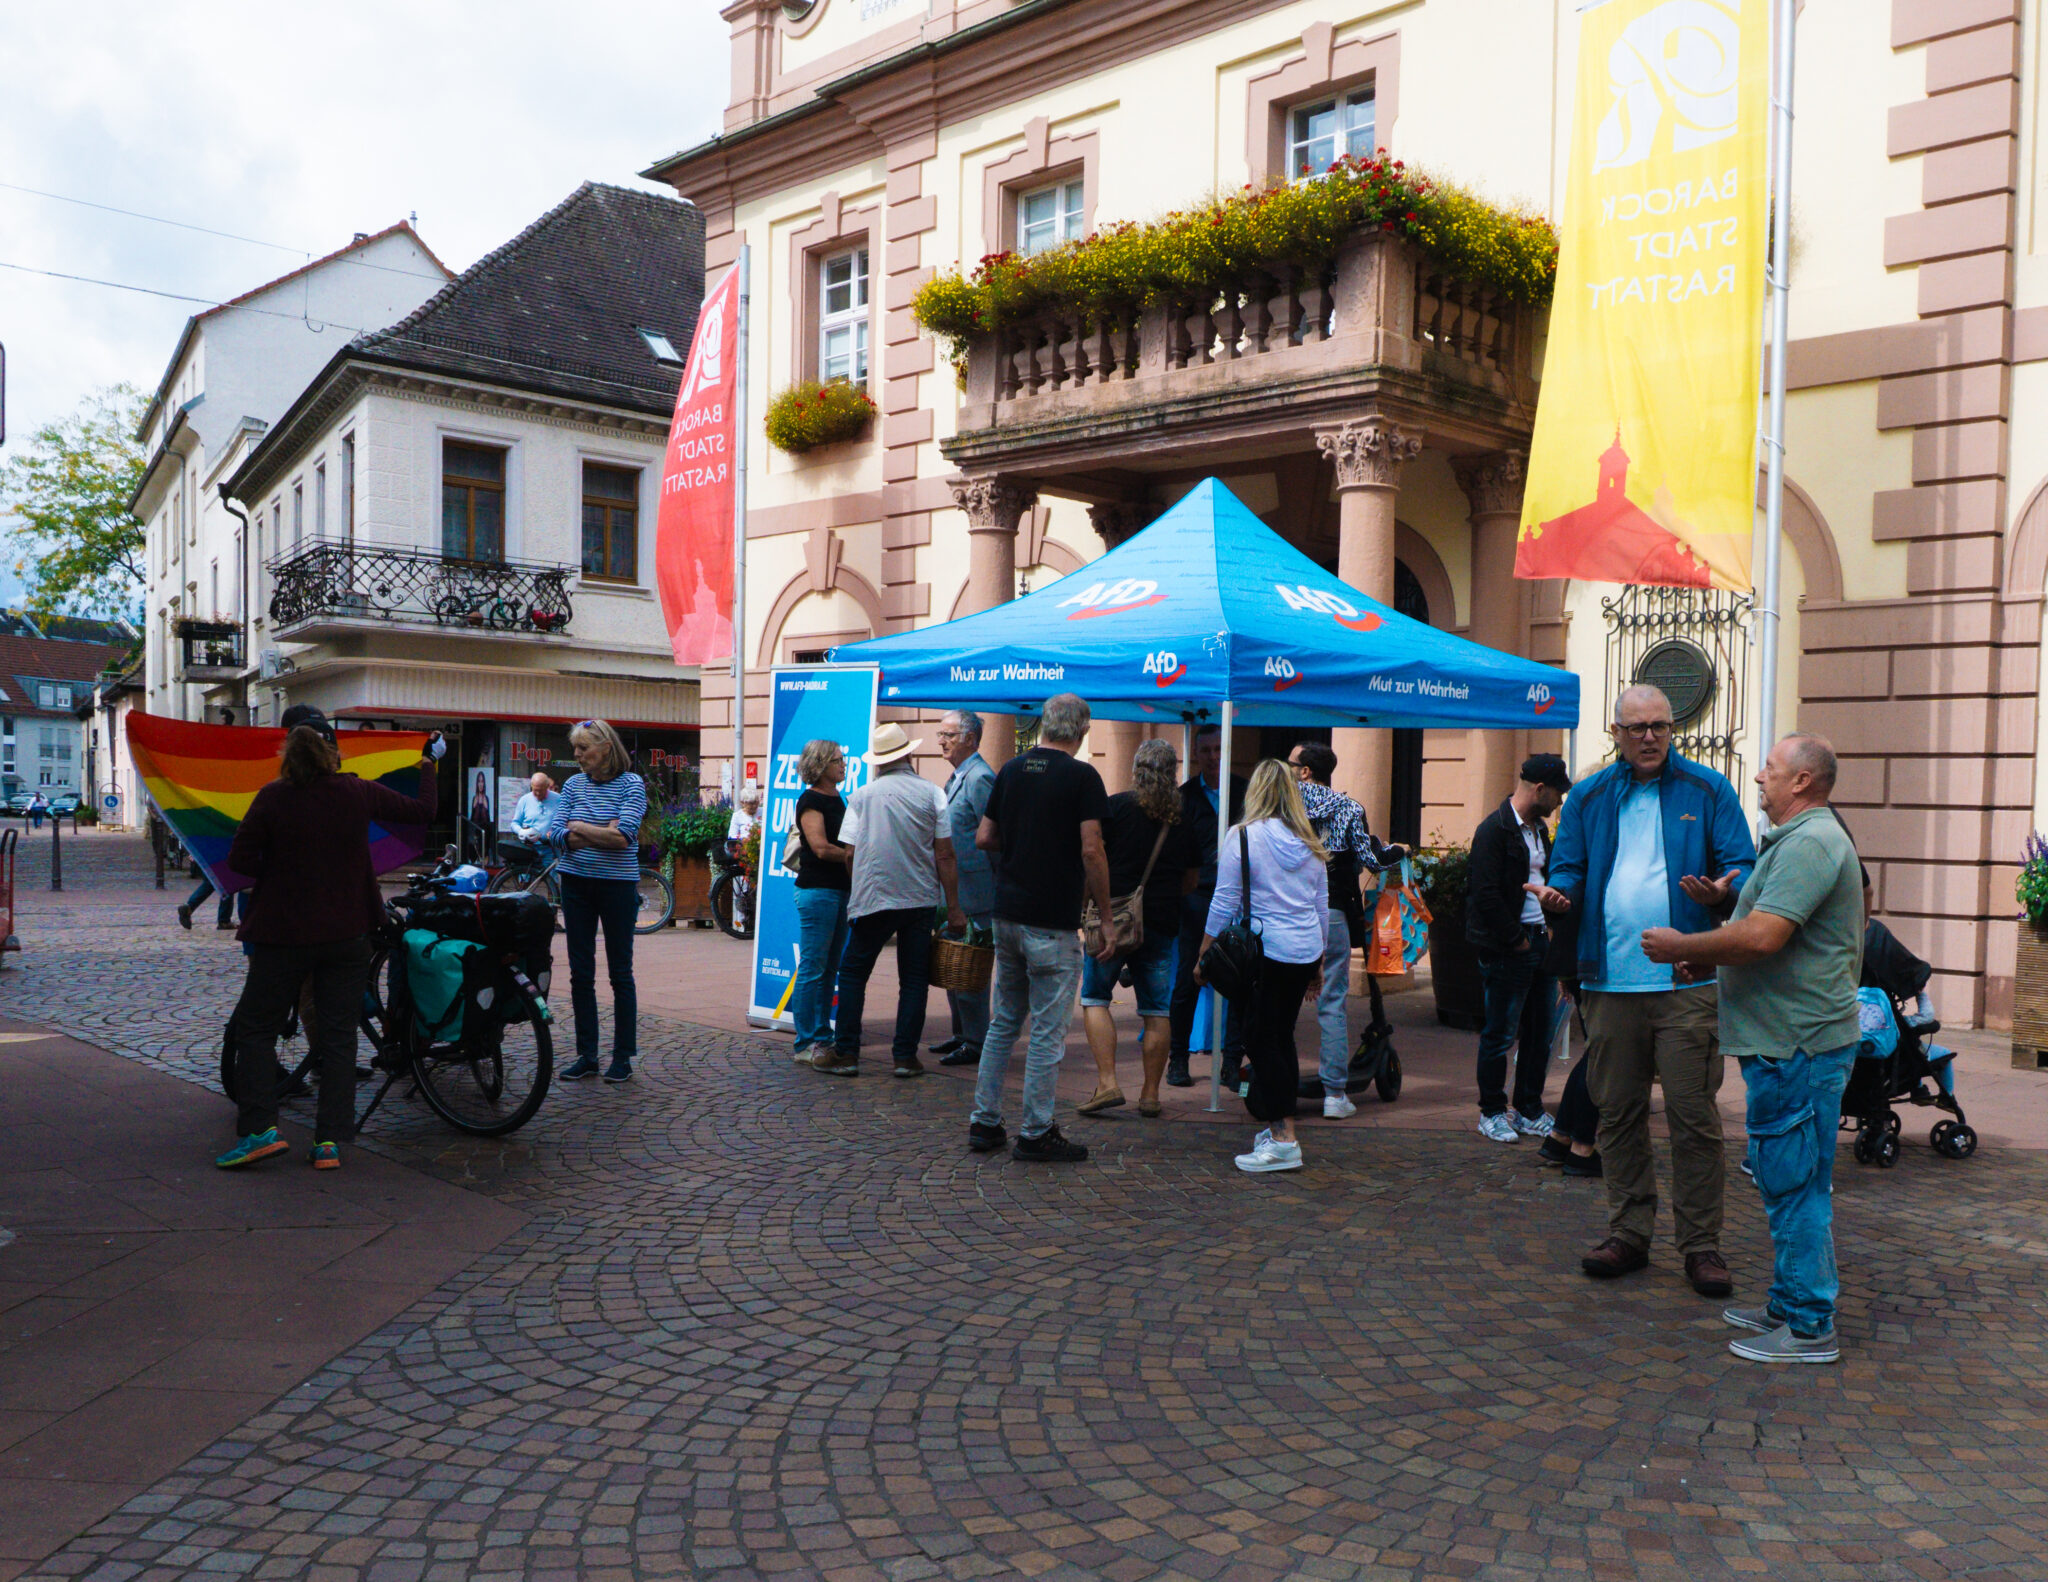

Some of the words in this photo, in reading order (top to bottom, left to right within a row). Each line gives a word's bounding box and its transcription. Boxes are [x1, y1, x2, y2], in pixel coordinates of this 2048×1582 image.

[1055, 578, 1158, 608] AfD
[1274, 585, 1358, 617] AfD
[950, 666, 976, 682] Mut
[979, 668, 1000, 681] zur
[1003, 662, 1064, 680] Wahrheit
[1142, 650, 1177, 674] AfD
[1264, 656, 1295, 678] AfD
[1368, 675, 1393, 692] Mut
[1395, 681, 1415, 694] zur
[1417, 678, 1470, 700] Wahrheit
[1526, 683, 1550, 702] AfD
[445, 723, 460, 734] 43
[509, 741, 552, 767] Pop
[650, 749, 689, 773] Pop
